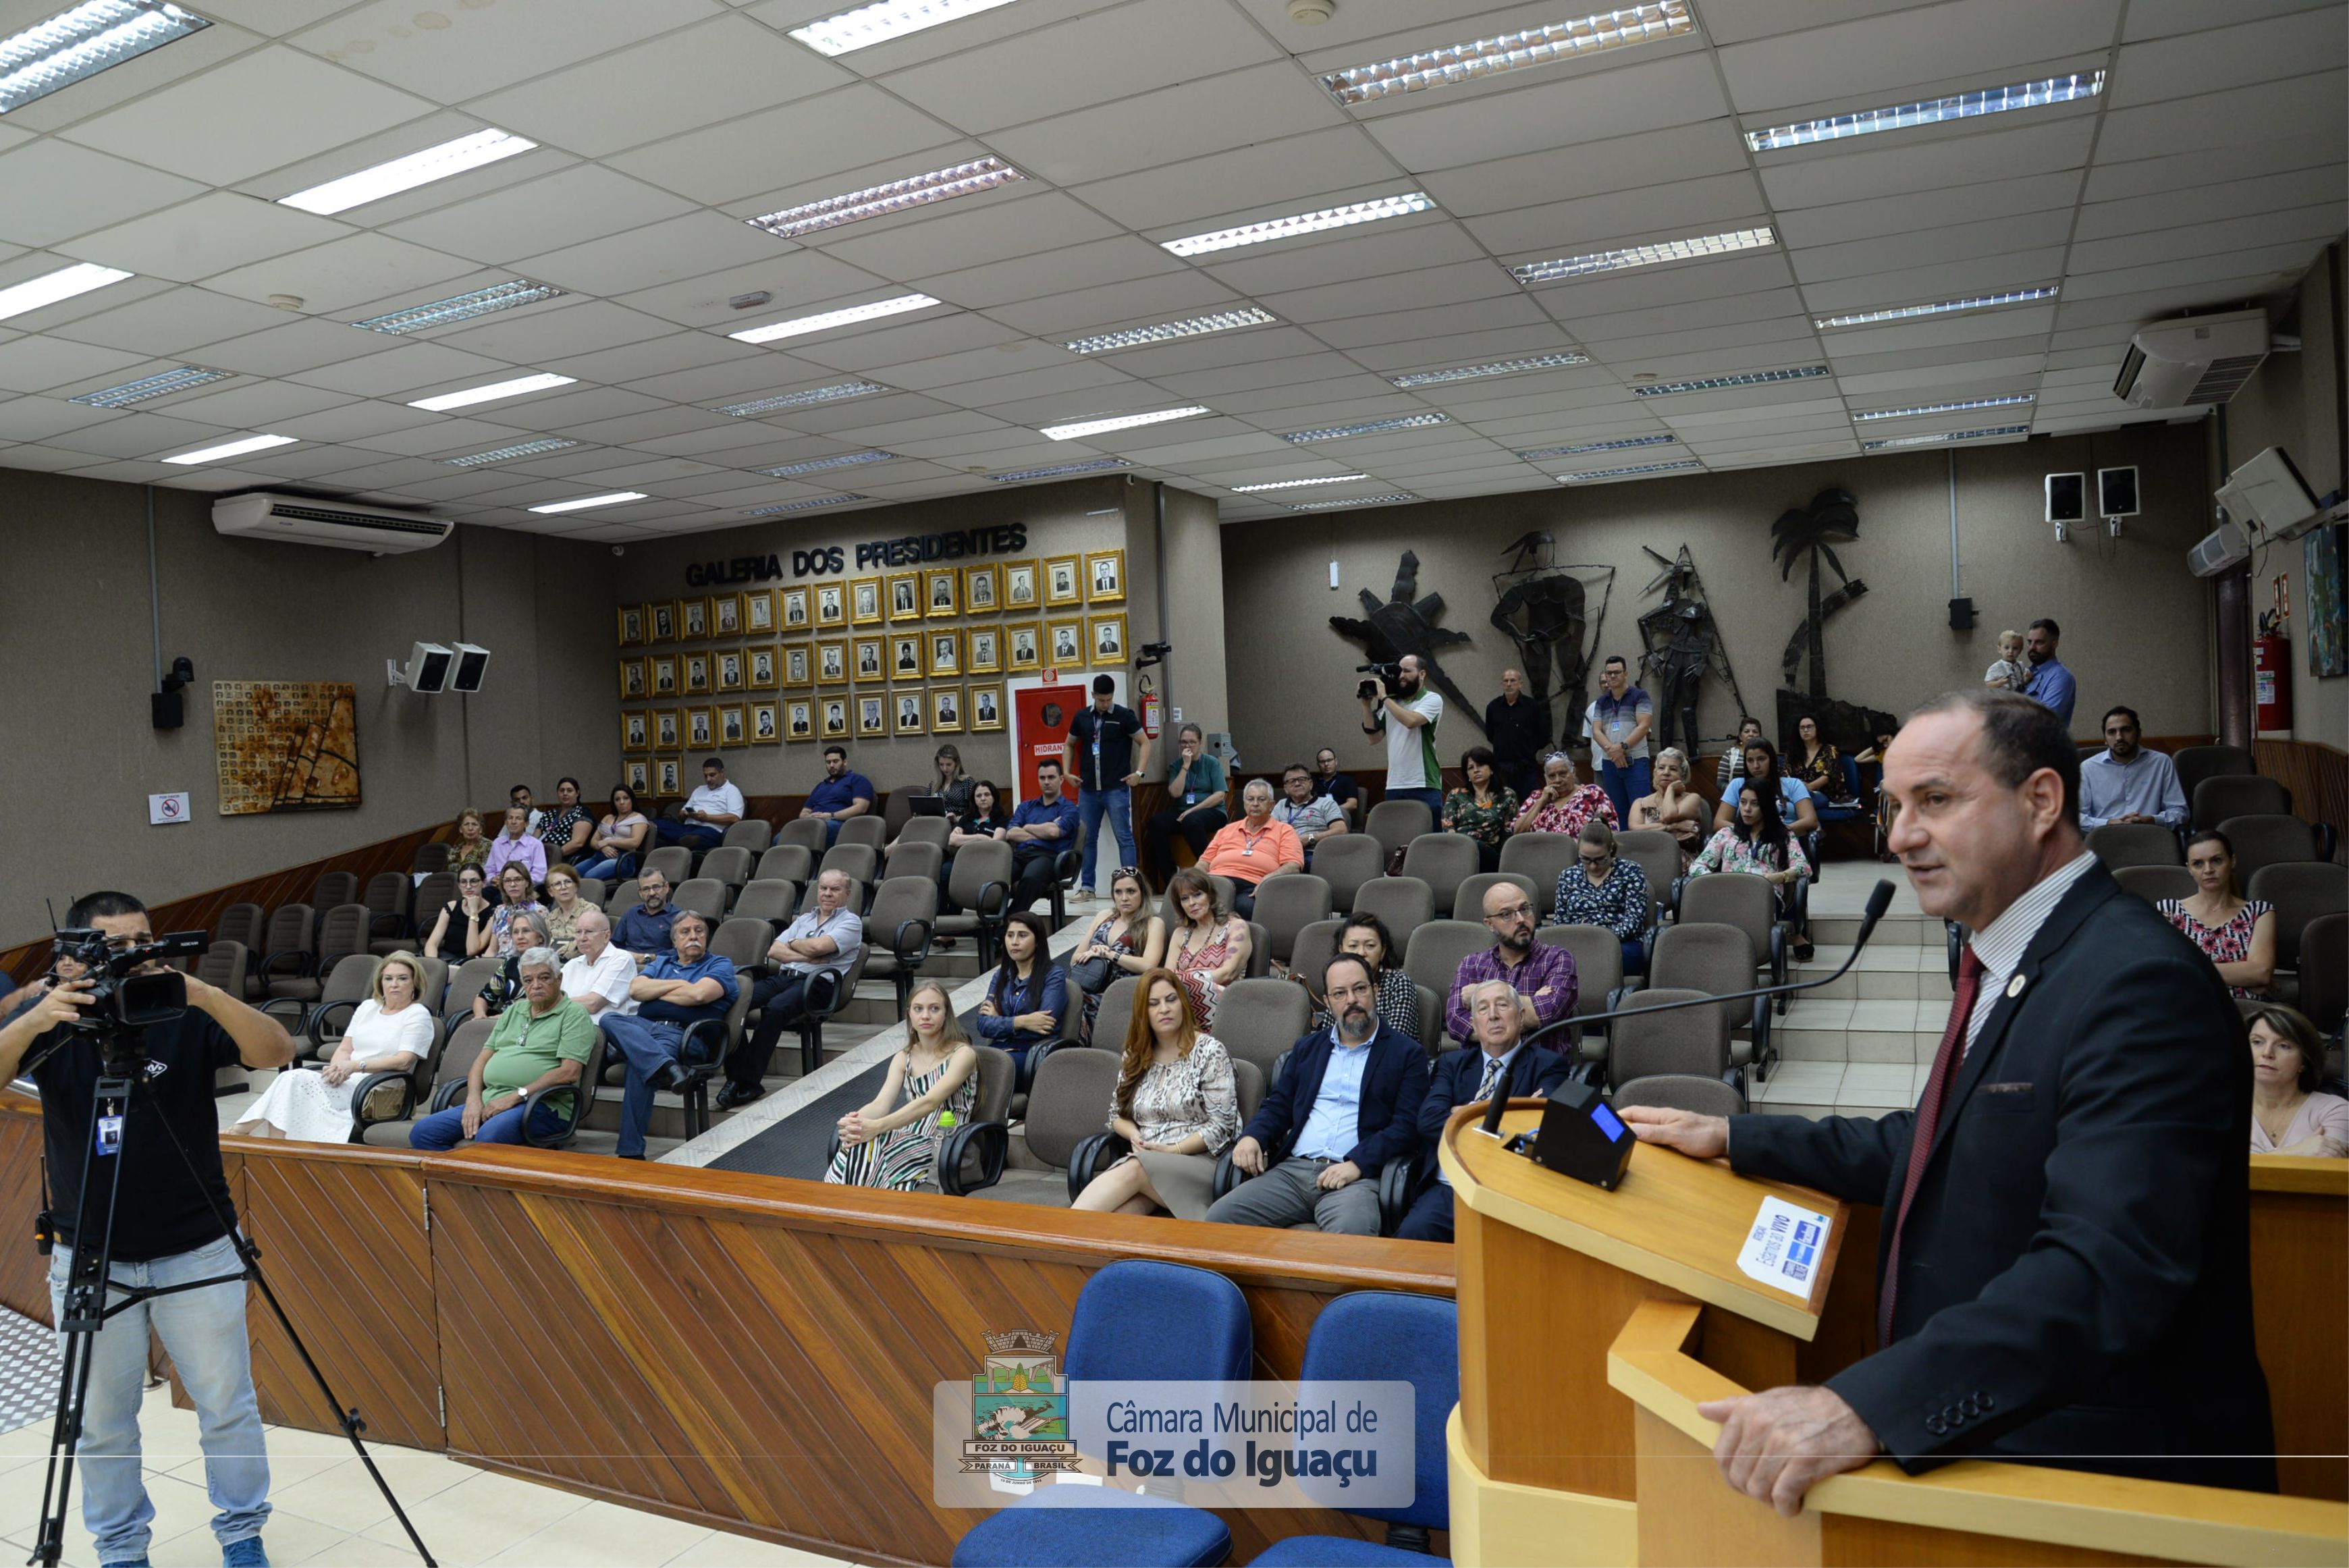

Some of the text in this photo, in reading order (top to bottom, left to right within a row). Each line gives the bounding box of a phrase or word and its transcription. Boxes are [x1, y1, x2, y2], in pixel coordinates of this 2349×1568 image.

[686, 522, 1027, 587] GALERIA DOS PRESIDENTES
[1770, 1214, 1790, 1233] VIVO
